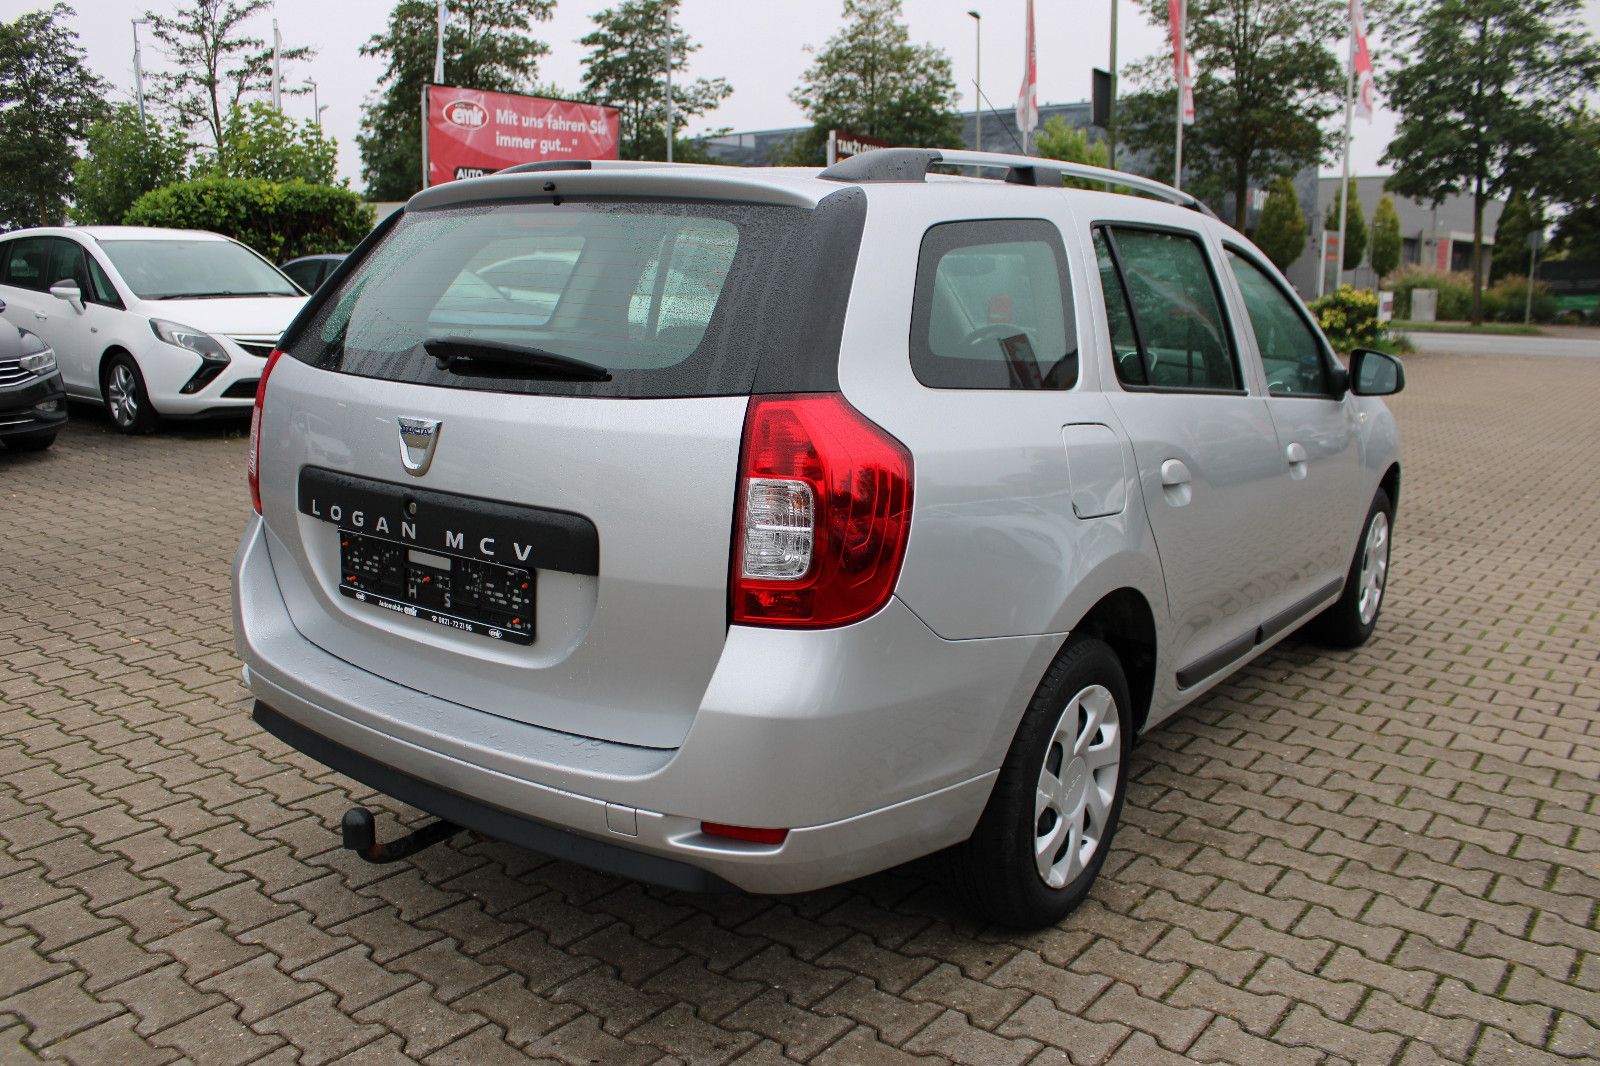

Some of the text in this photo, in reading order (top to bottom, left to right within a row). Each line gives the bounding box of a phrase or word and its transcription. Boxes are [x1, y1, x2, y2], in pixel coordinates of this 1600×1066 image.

[451, 105, 483, 126] emir
[495, 109, 607, 136] Mit uns fahren Sie
[495, 131, 536, 150] immer
[400, 424, 433, 436] DACIA
[311, 499, 416, 540] LOGAN
